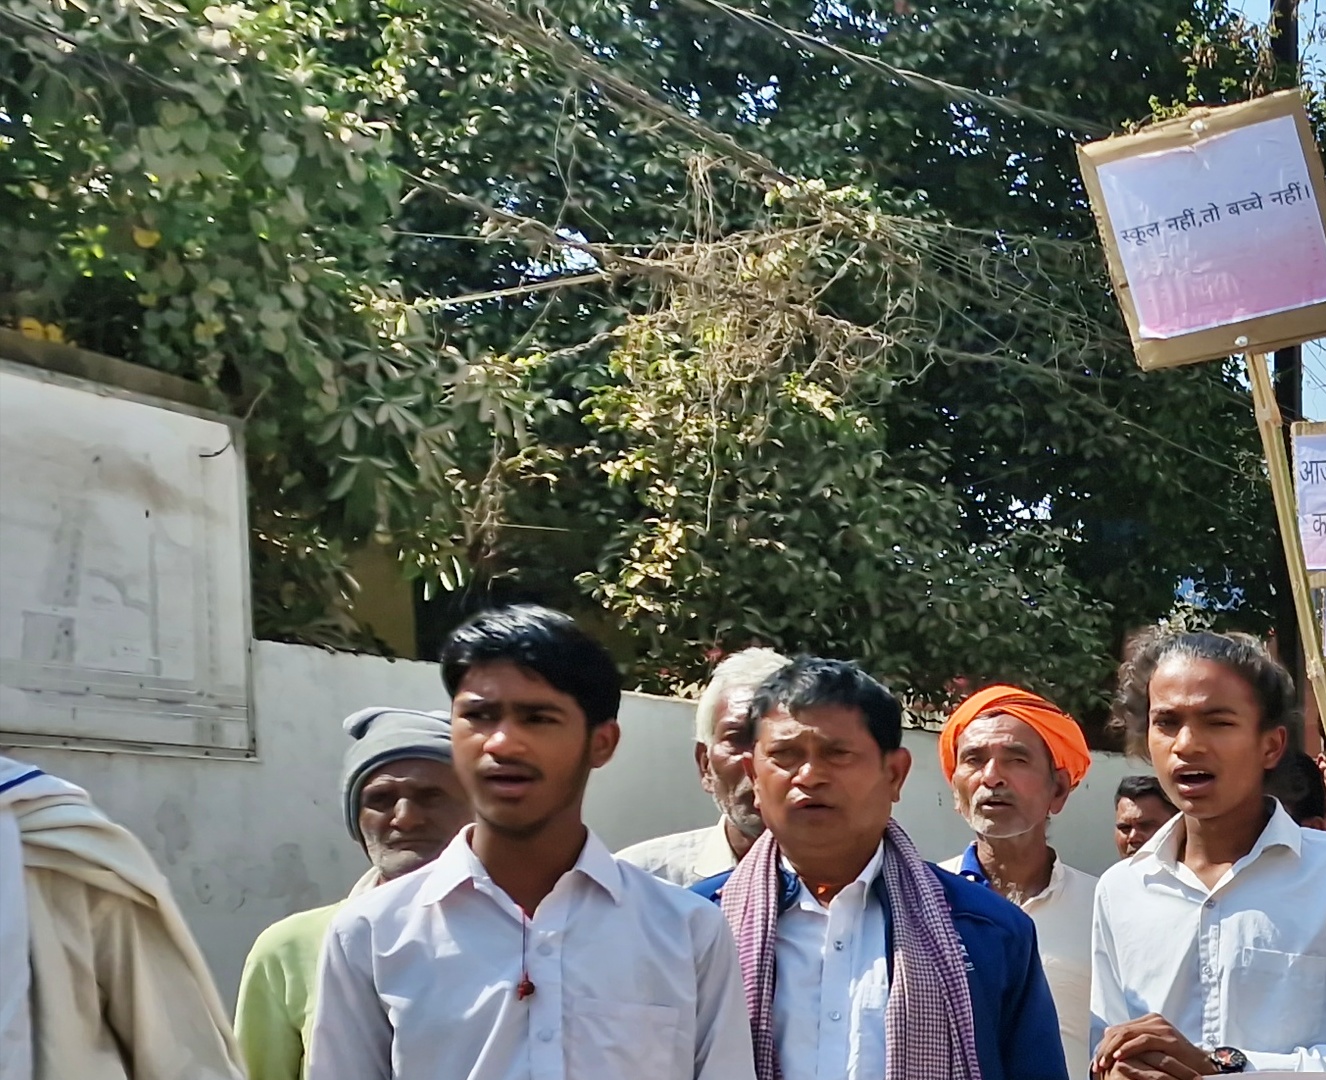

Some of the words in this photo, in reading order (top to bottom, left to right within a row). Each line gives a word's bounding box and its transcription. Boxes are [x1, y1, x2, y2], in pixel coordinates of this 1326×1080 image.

[1120, 222, 1160, 246] स्कूल
[1227, 192, 1262, 216] बच्चे
[1269, 182, 1310, 206] नहीं।
